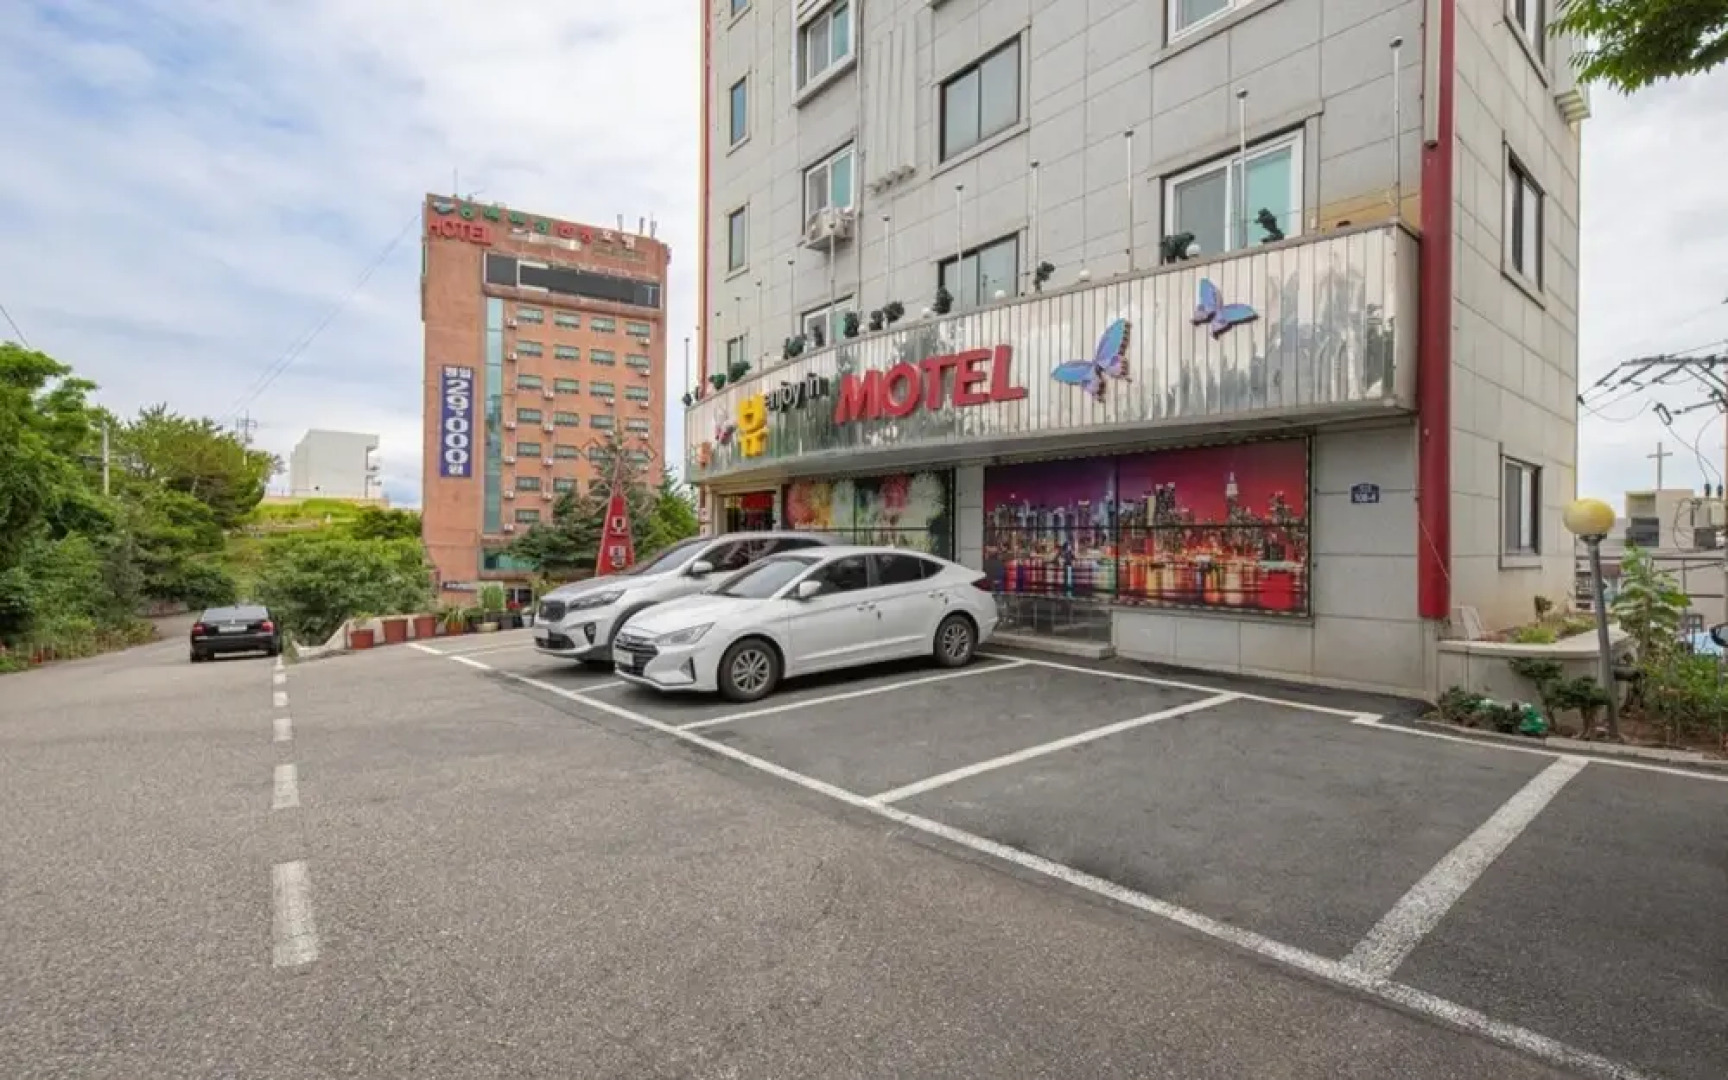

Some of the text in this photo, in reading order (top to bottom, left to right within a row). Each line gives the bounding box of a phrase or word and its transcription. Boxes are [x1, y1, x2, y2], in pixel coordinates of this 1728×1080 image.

[429, 219, 491, 246] HOTEL
[764, 380, 806, 413] enjoy
[834, 344, 1028, 424] MOTEL
